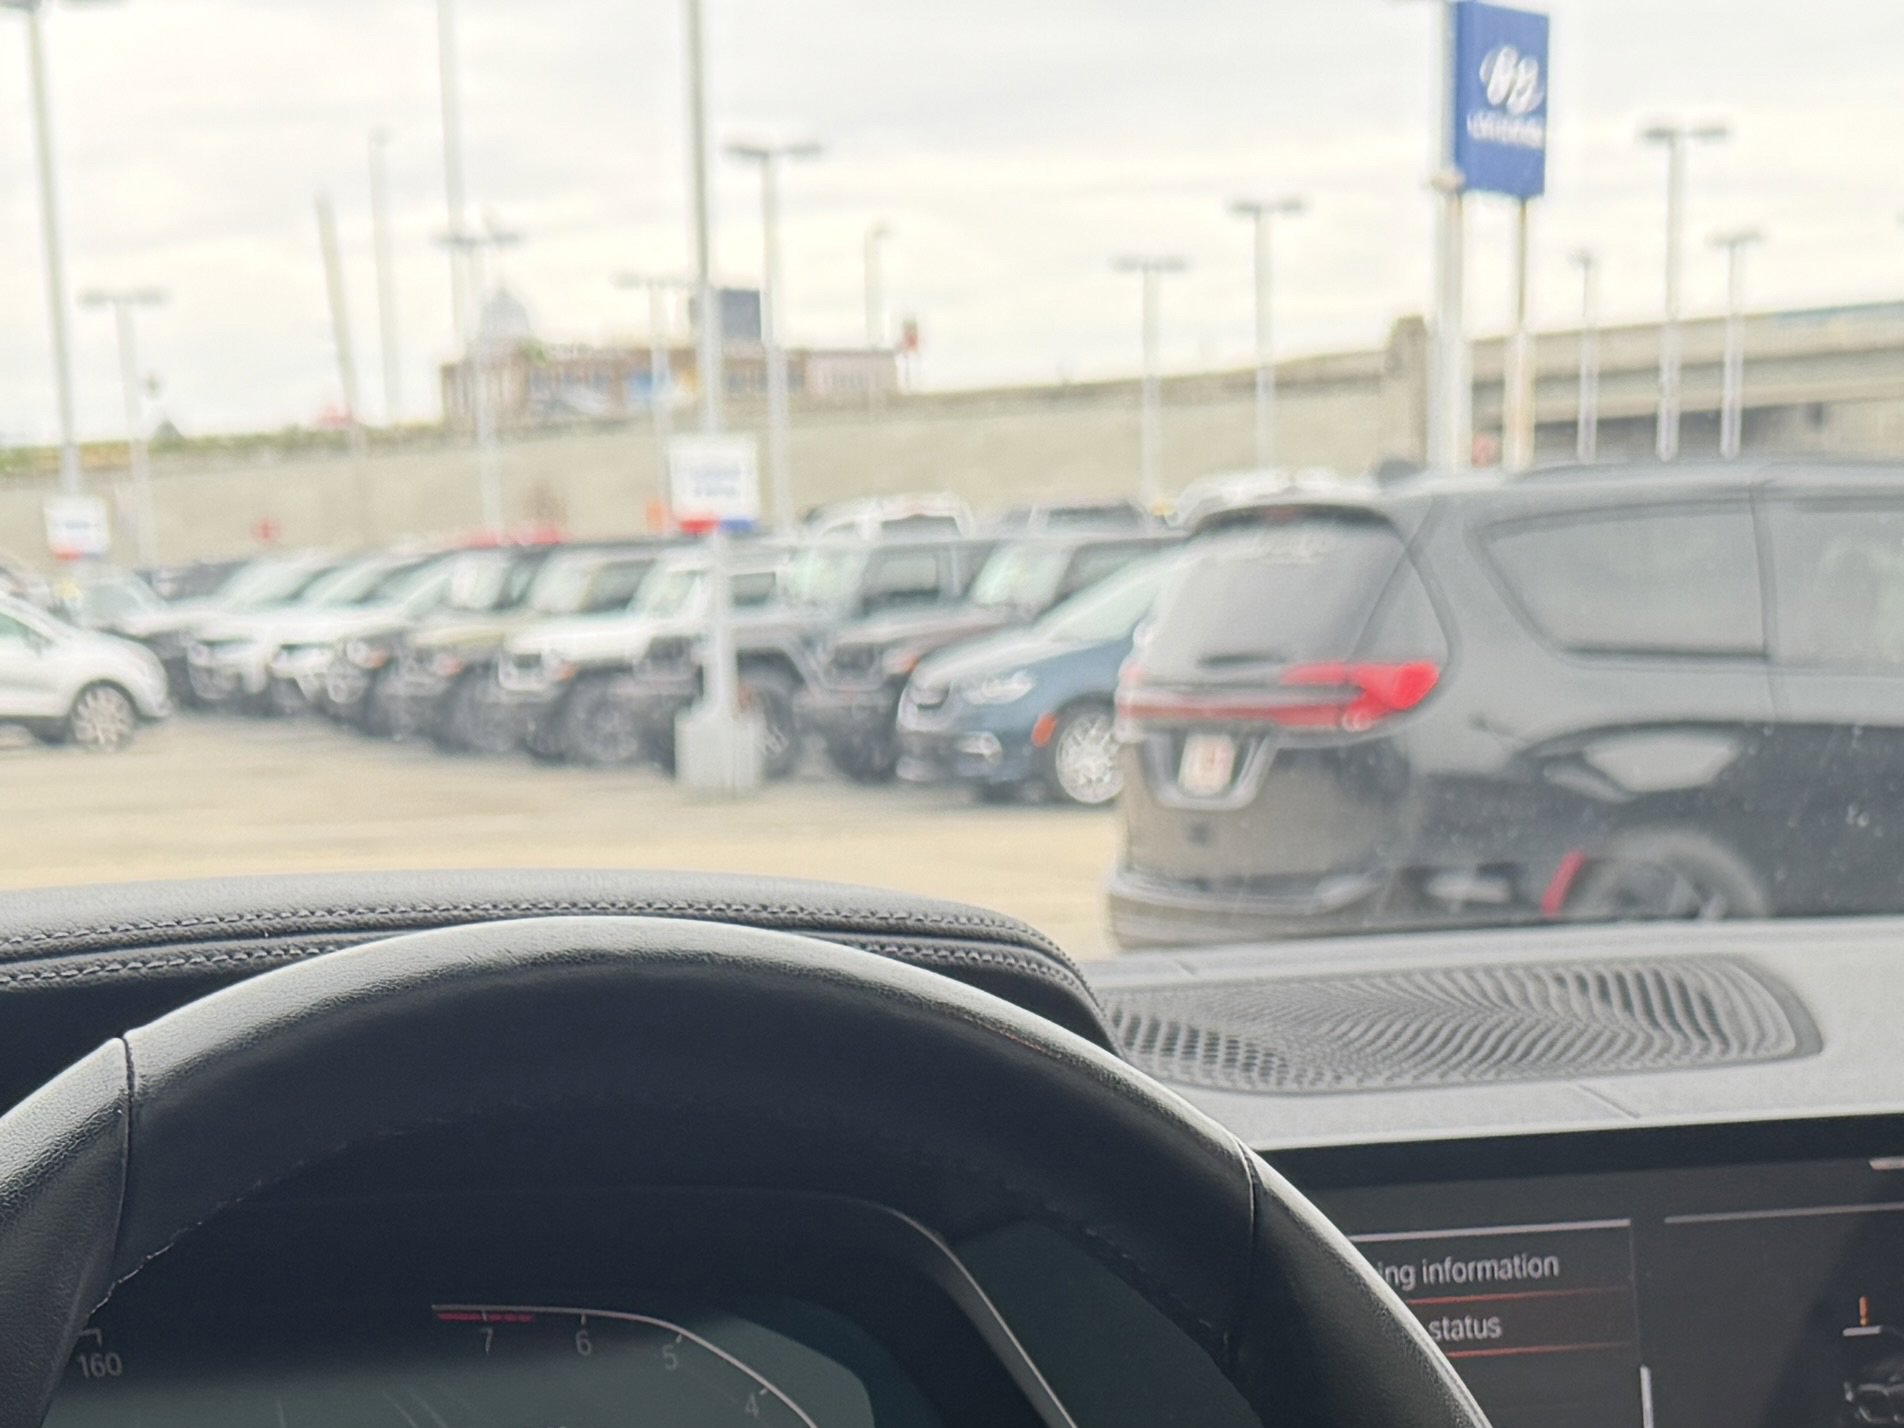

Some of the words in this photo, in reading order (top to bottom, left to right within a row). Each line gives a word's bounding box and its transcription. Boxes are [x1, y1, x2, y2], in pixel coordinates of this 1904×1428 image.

[1377, 1261, 1416, 1291] ing
[1423, 1253, 1560, 1285] information
[479, 1327, 495, 1354] 7
[1428, 1315, 1503, 1341] status
[575, 1330, 592, 1356] 6
[78, 1352, 123, 1379] 160
[661, 1344, 679, 1371] 5
